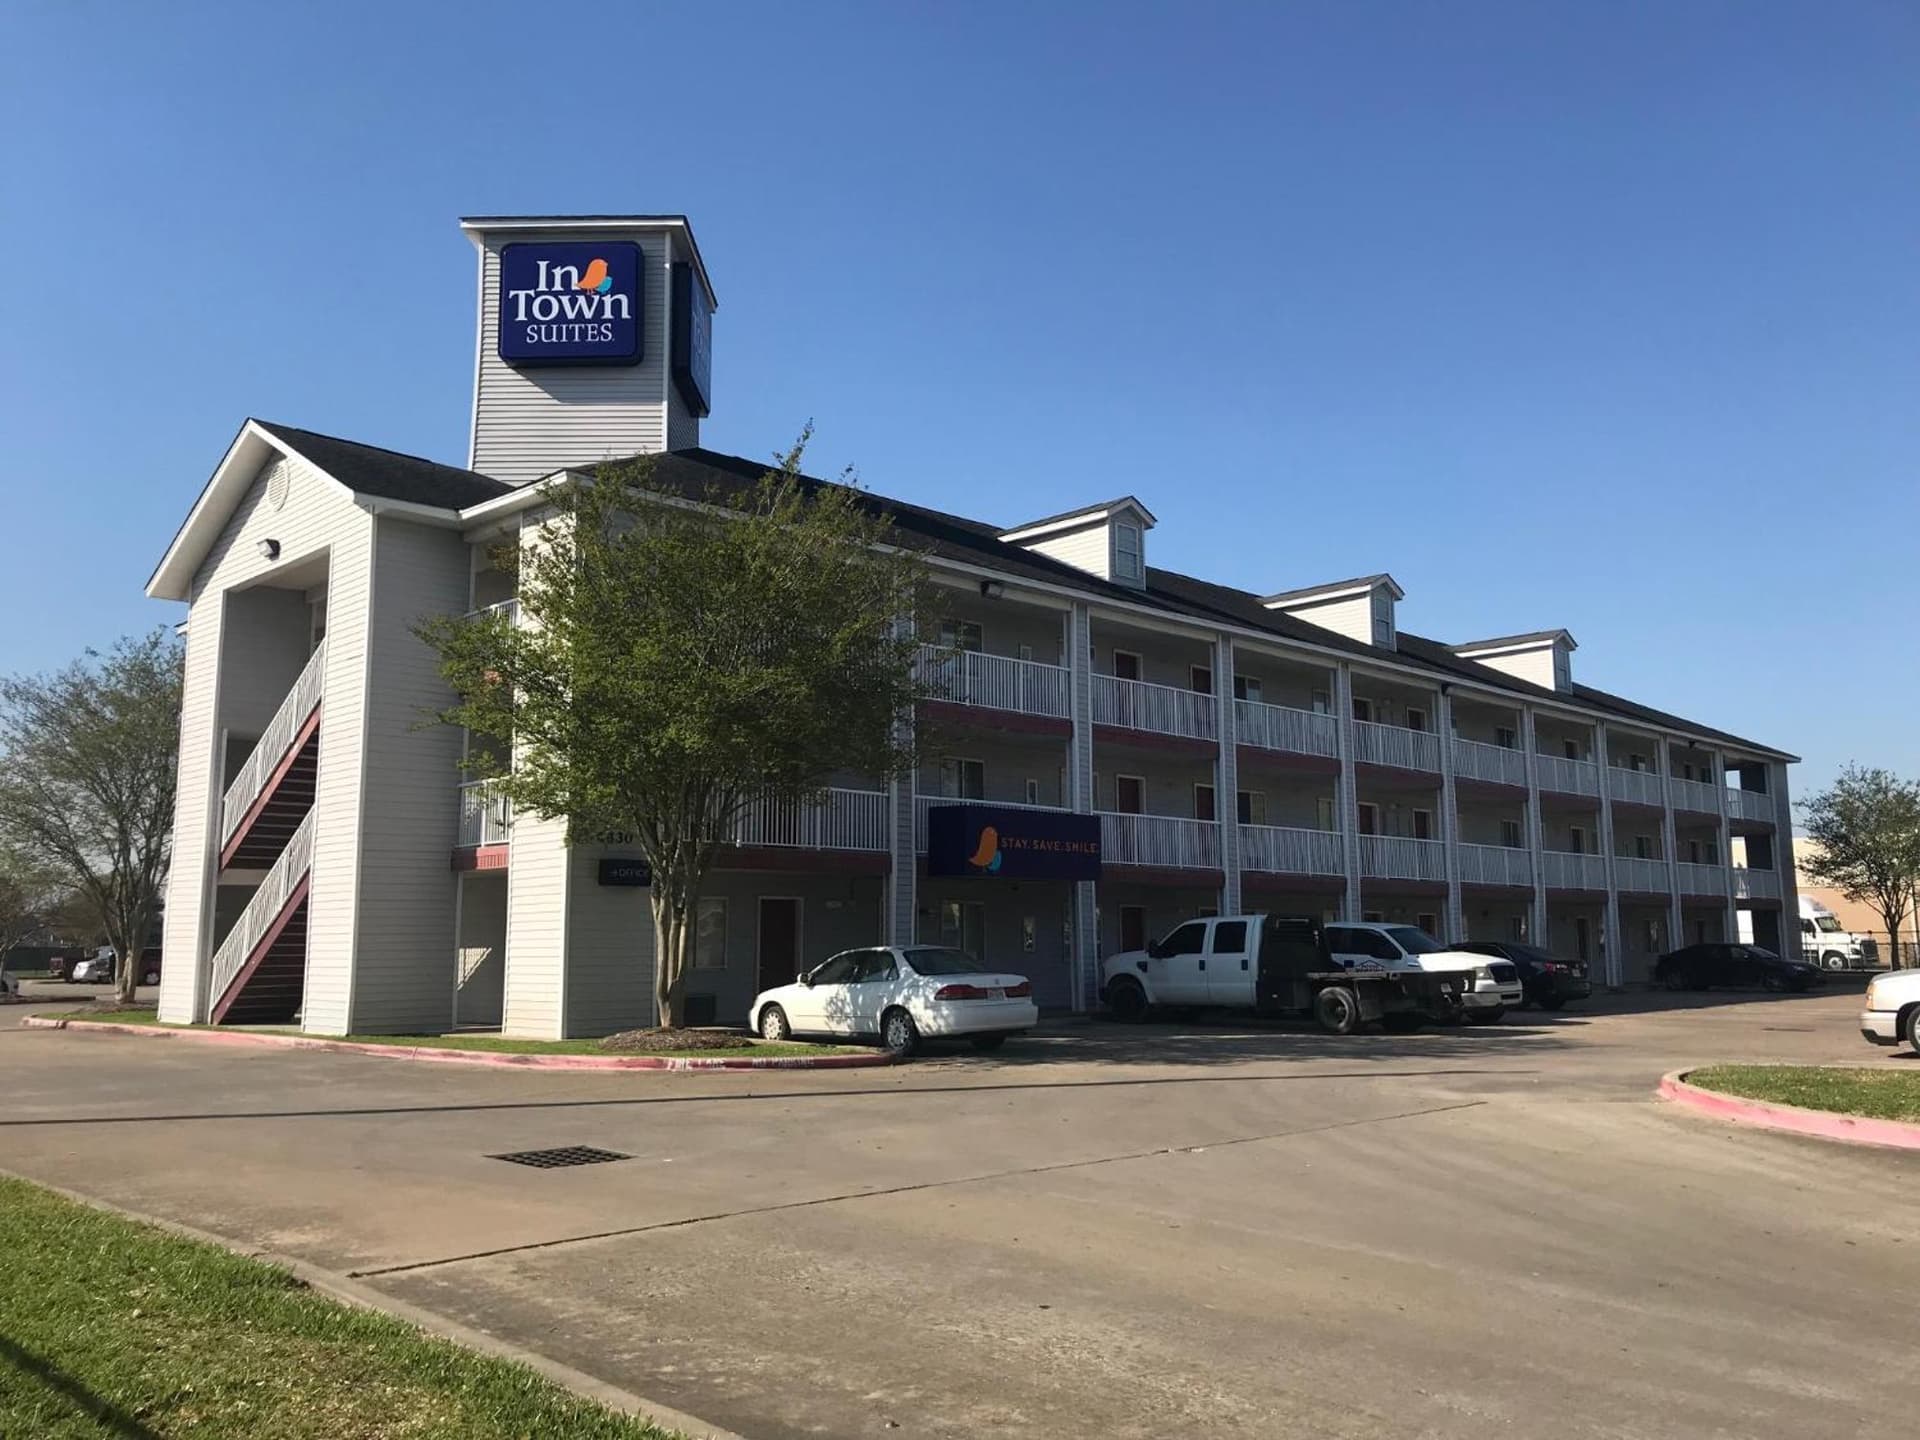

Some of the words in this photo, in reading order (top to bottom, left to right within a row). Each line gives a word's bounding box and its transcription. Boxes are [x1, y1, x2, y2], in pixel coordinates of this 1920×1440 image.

[536, 261, 579, 291] In
[508, 290, 632, 321] Town
[526, 323, 613, 343] SUITES
